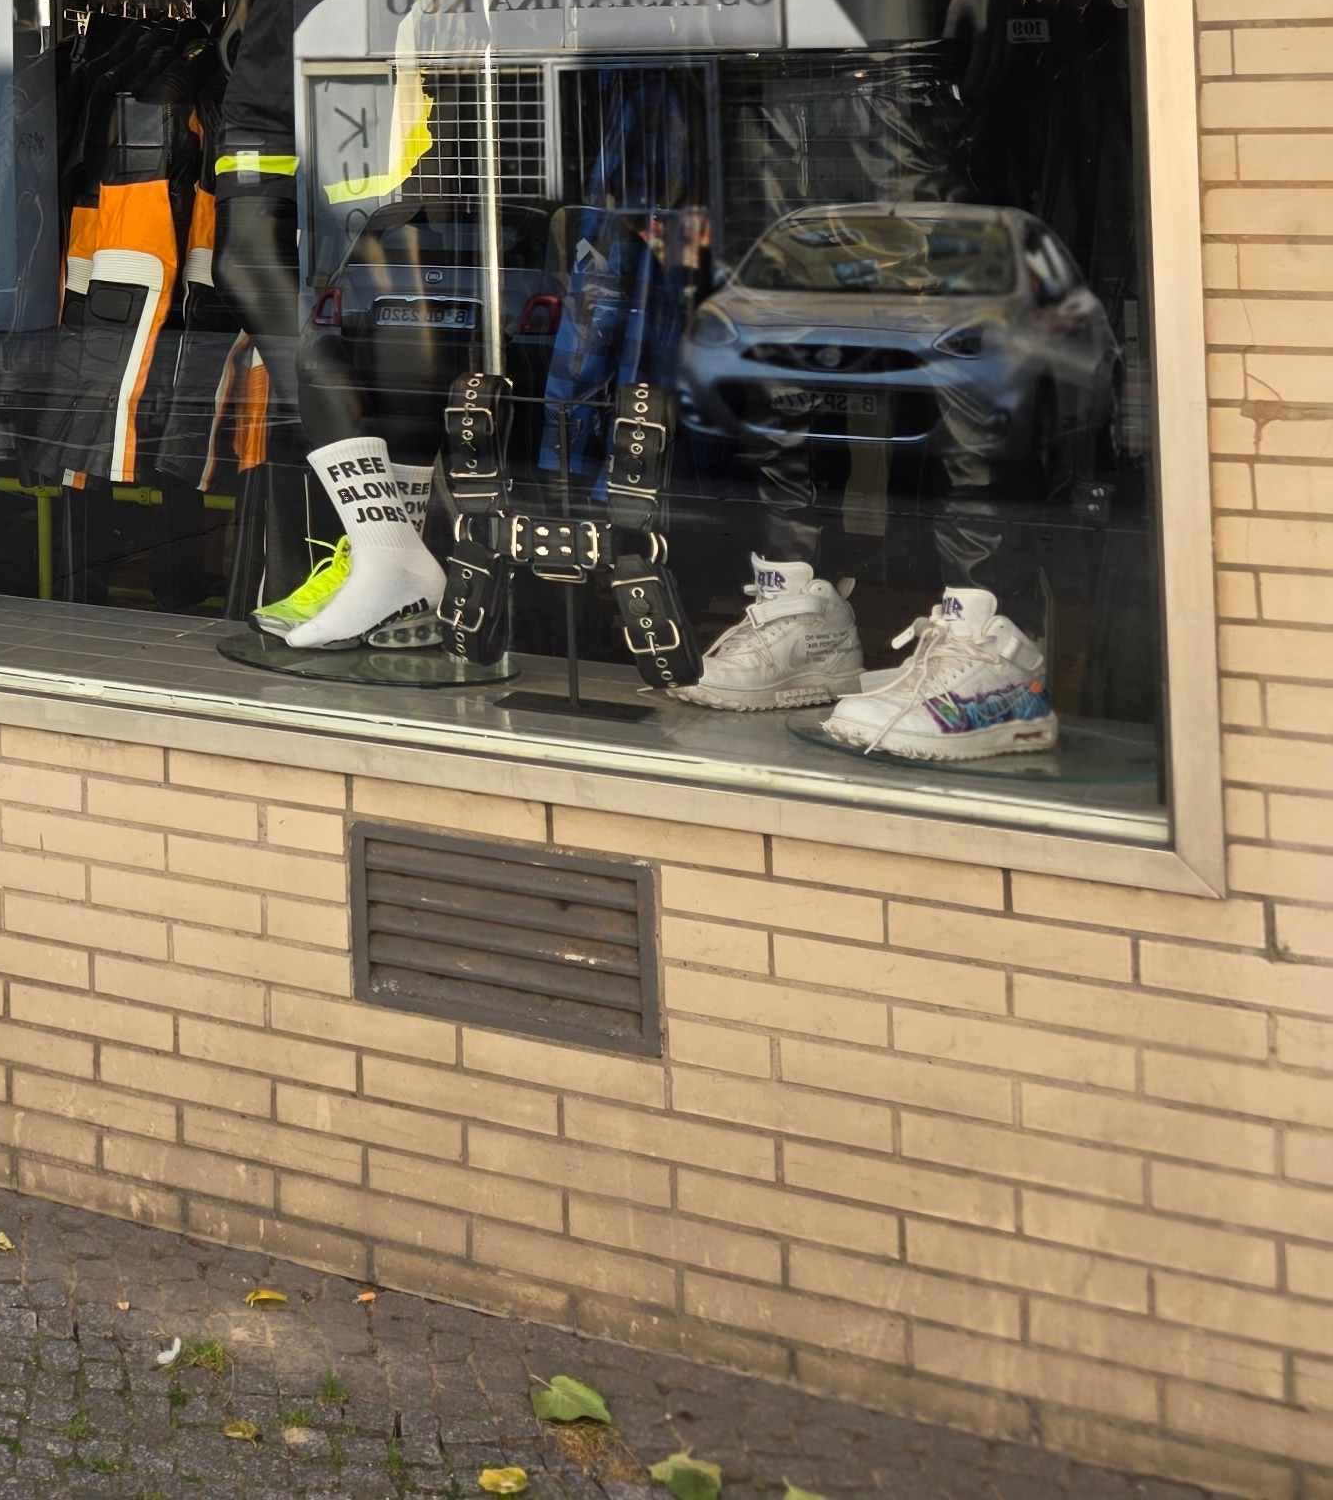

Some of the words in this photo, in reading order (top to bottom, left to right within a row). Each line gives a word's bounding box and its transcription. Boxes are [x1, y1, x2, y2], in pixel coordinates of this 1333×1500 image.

[327, 456, 386, 483] FREE
[336, 481, 398, 505] BLOW
[396, 480, 430, 496] REE
[356, 505, 408, 524] JOBS
[406, 501, 428, 515] OW
